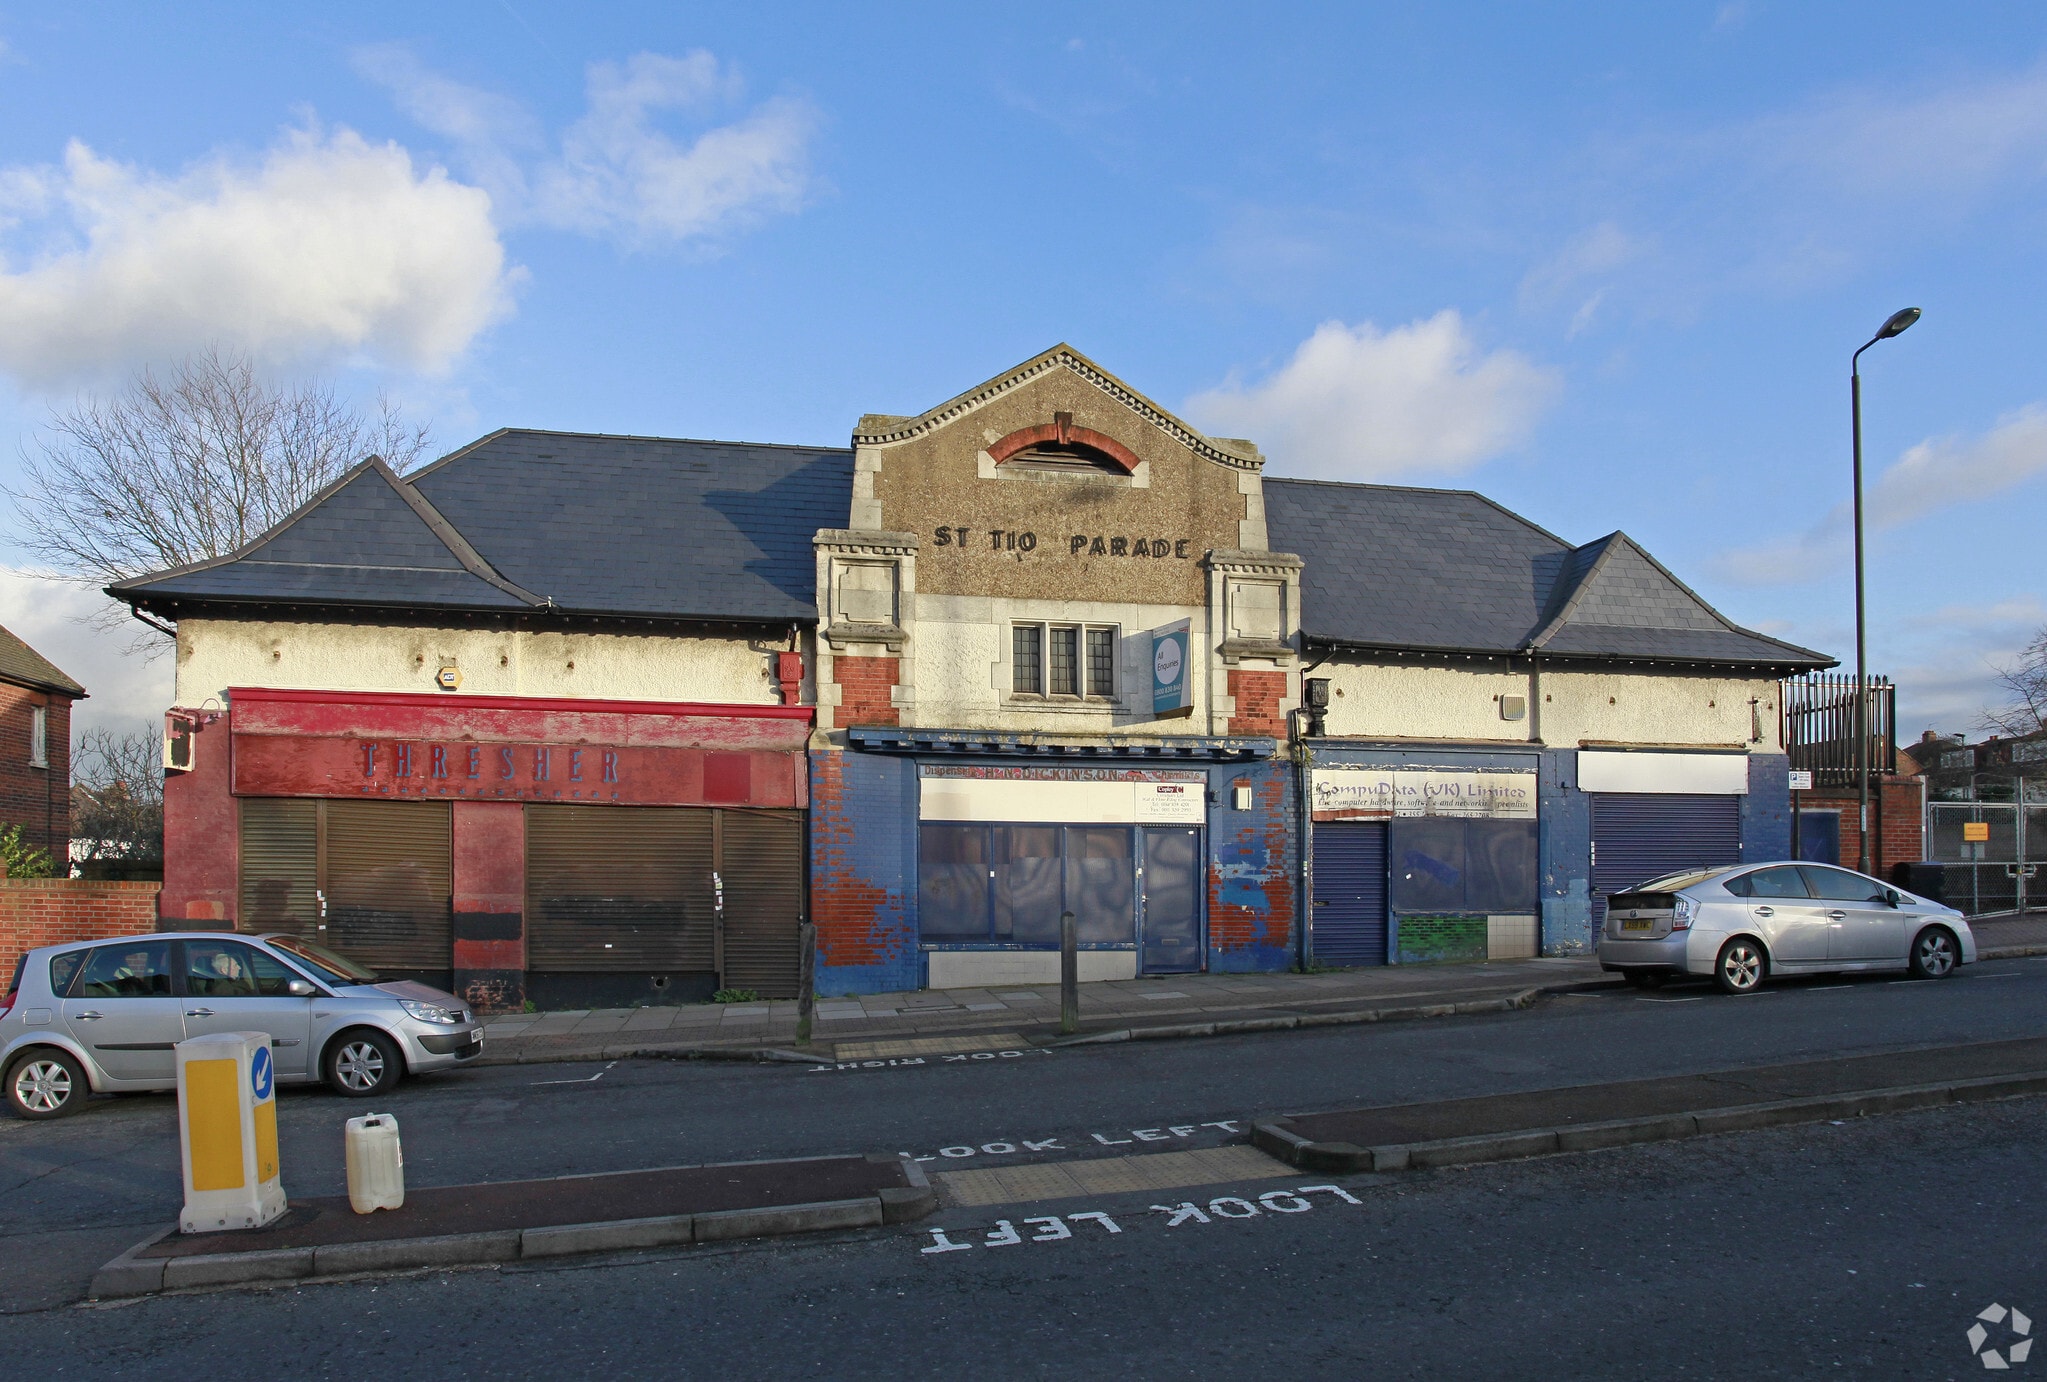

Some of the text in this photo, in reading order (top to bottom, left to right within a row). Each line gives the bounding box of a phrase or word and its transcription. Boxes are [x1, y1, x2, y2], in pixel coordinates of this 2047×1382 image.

[933, 526, 970, 547] ST
[1070, 534, 1190, 559] PARADE
[1157, 660, 1179, 672] Enquiries
[360, 743, 619, 783] THRESHER
[1320, 781, 1417, 797] CompuData
[1467, 783, 1526, 798] Limited
[808, 1048, 1053, 1072] LOOK RIGHT
[899, 1120, 1240, 1162] LOOK LEFT
[920, 1185, 1363, 1254] LOOK LEFT
